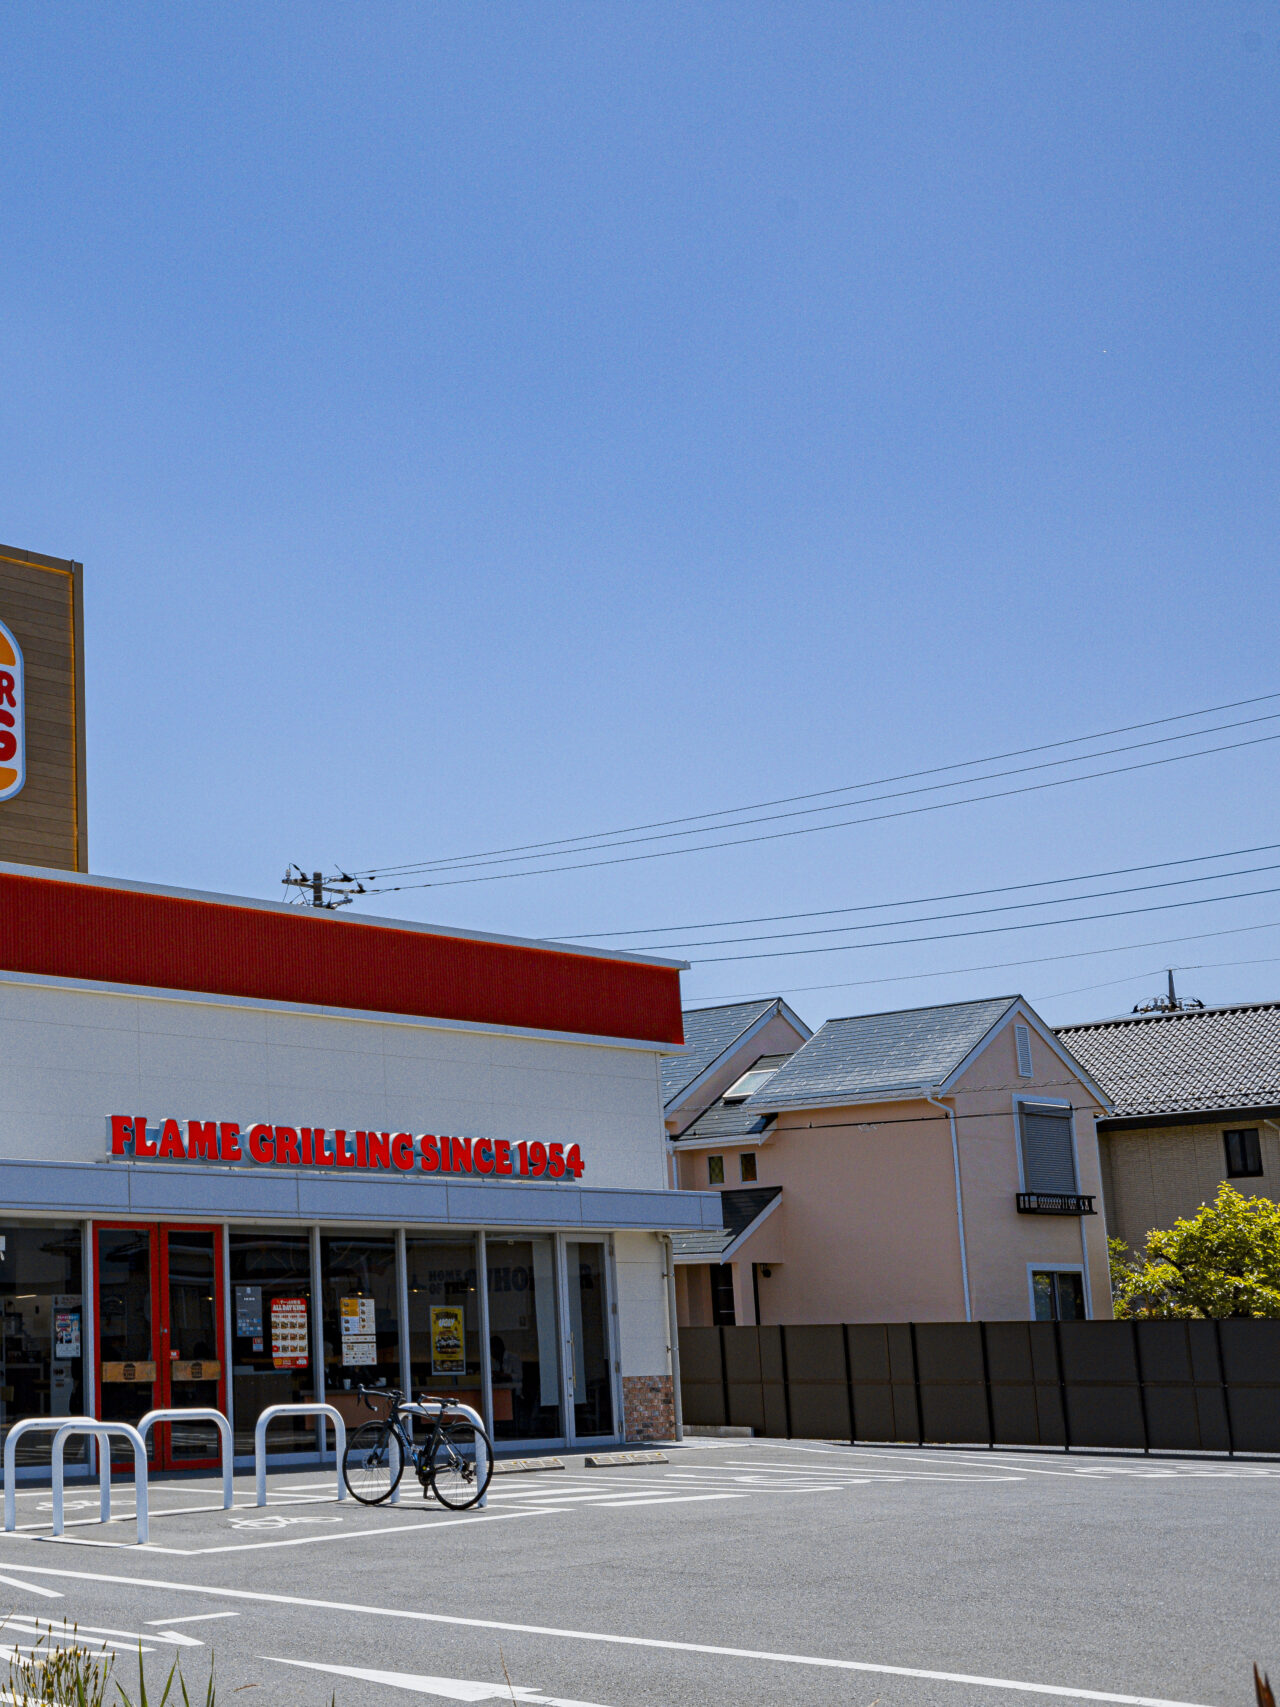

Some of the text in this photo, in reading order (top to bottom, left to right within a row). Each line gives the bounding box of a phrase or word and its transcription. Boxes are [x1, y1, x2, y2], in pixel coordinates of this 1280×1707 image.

[108, 1115, 586, 1179] FLAME GRILLING SINCE 1954
[428, 1270, 462, 1281] HOME
